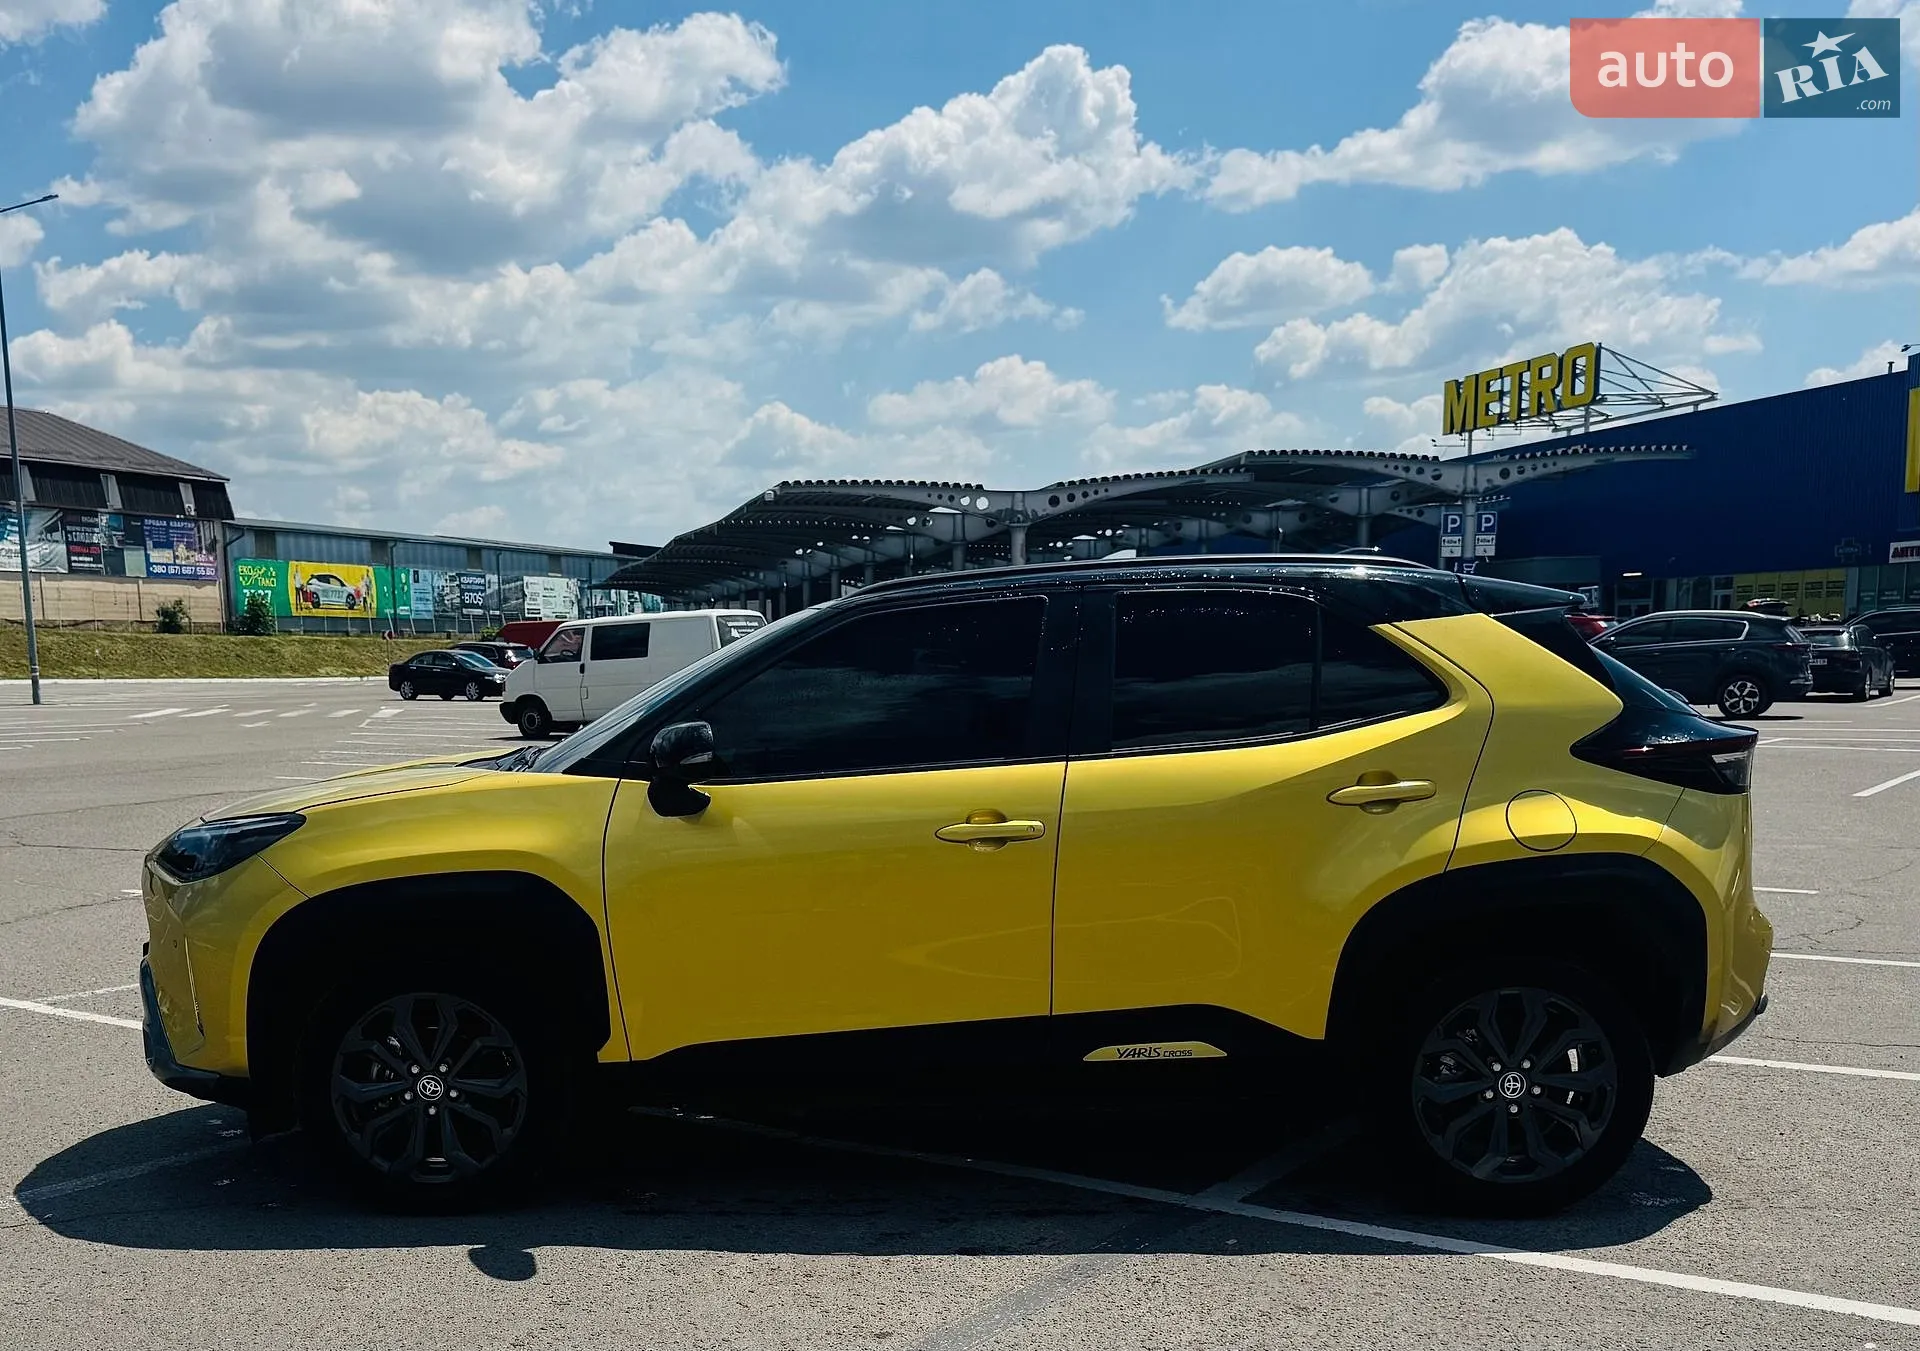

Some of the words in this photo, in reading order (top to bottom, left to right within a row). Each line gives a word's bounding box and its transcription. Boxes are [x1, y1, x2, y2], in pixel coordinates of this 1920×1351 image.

[1442, 342, 1600, 436] METRO
[1447, 515, 1461, 533] P
[1481, 514, 1495, 532] P
[1116, 1046, 1162, 1058] YARIS
[1163, 1049, 1193, 1058] CROSS
